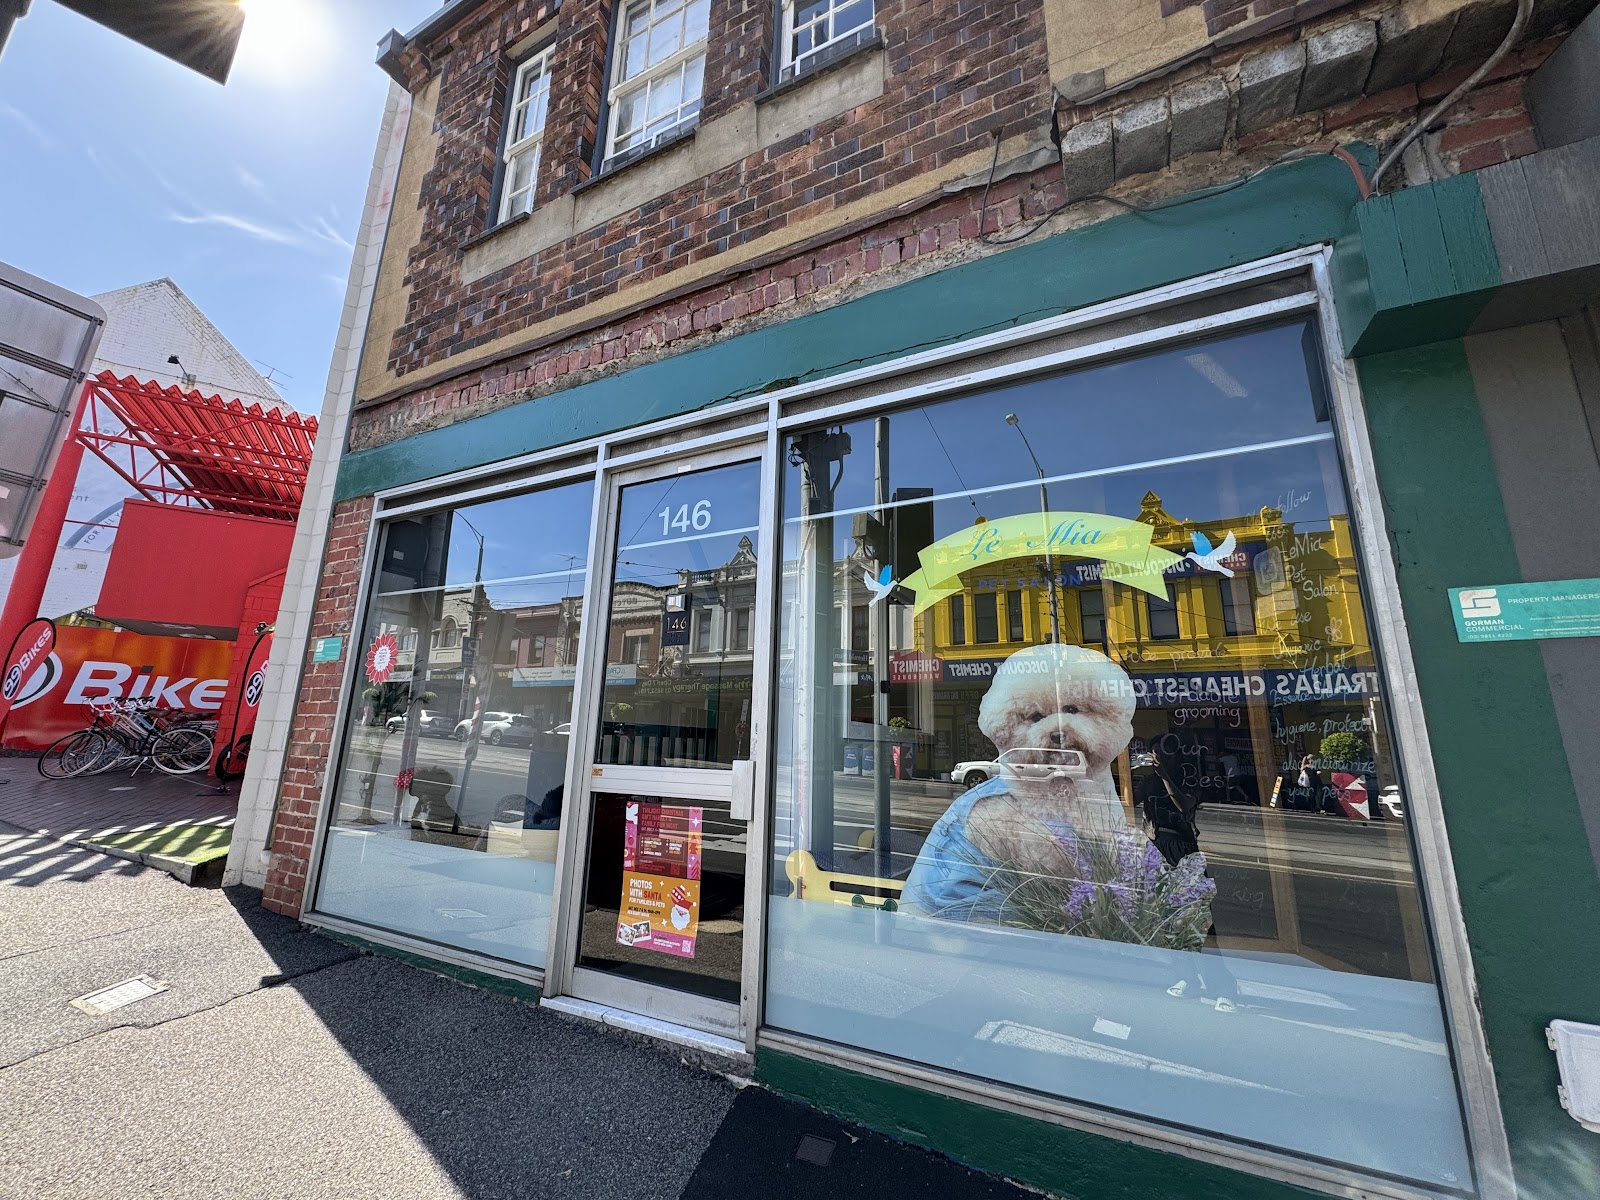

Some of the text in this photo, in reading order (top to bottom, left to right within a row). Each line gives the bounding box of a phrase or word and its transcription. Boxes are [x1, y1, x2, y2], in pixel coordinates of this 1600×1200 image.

[658, 500, 712, 536] 146
[84, 530, 100, 544] FOR
[960, 518, 1110, 561] Le Mia
[978, 575, 1081, 590] PET SALON
[1302, 575, 1339, 600] Salon
[1507, 593, 1600, 604] PROPERTY MANAGERS
[1465, 624, 1525, 632] COMMERCIAL
[4, 666, 22, 699] 99
[1174, 705, 1241, 728] grooming
[1181, 763, 1235, 788] Best
[629, 878, 653, 889] PHOTOS
[629, 888, 662, 900] WITH SANTA
